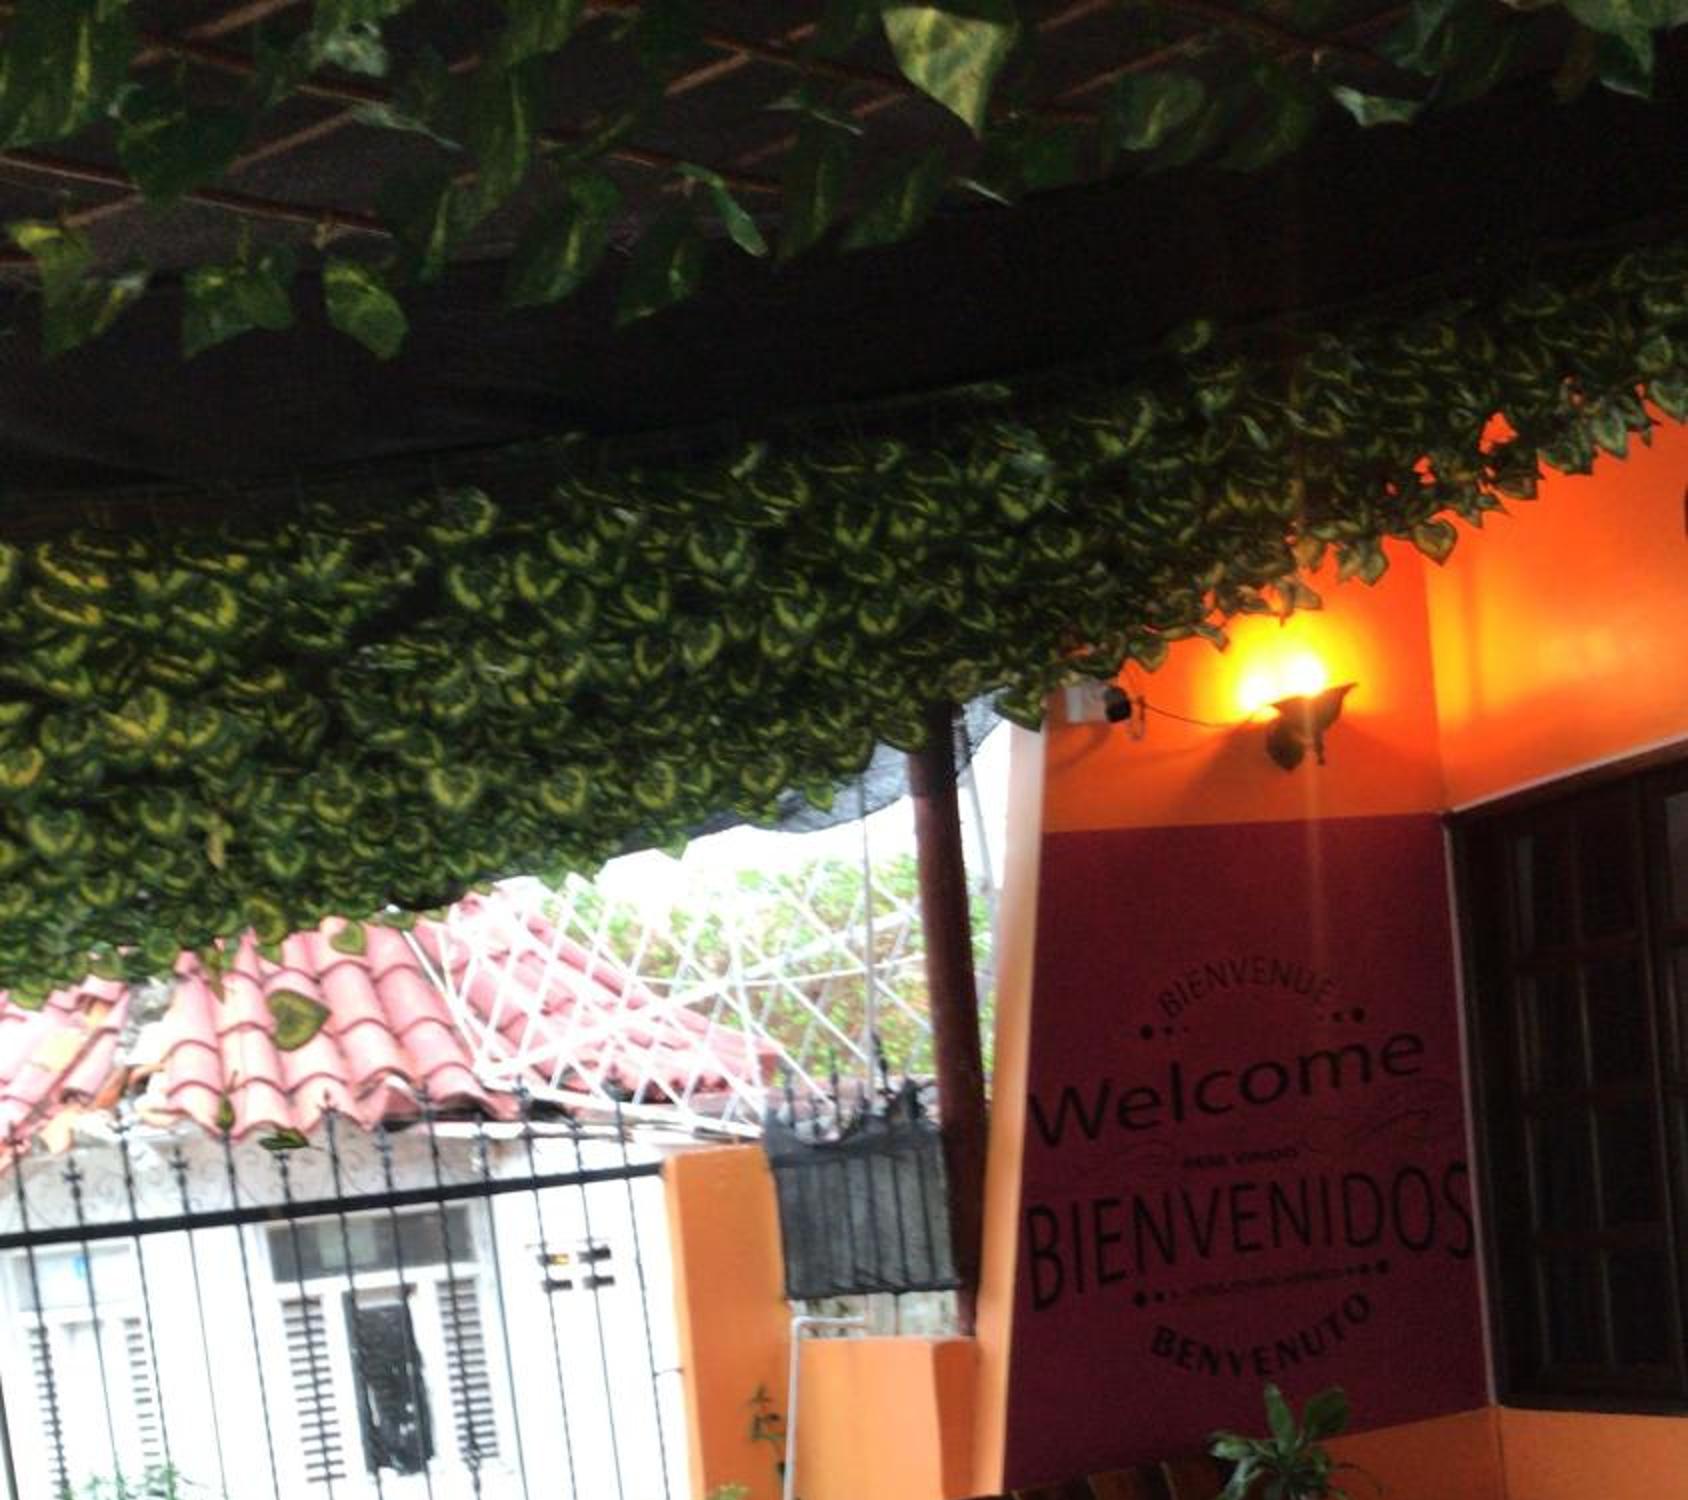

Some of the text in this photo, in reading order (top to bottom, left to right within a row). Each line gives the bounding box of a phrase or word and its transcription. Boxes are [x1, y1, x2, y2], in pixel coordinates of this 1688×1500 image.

[1158, 956, 1334, 1019] BIENVENUE
[1030, 1032, 1425, 1148] Welcome
[1024, 1160, 1475, 1311] BIENVENIDOS
[1150, 1292, 1373, 1376] BENVENUTO
